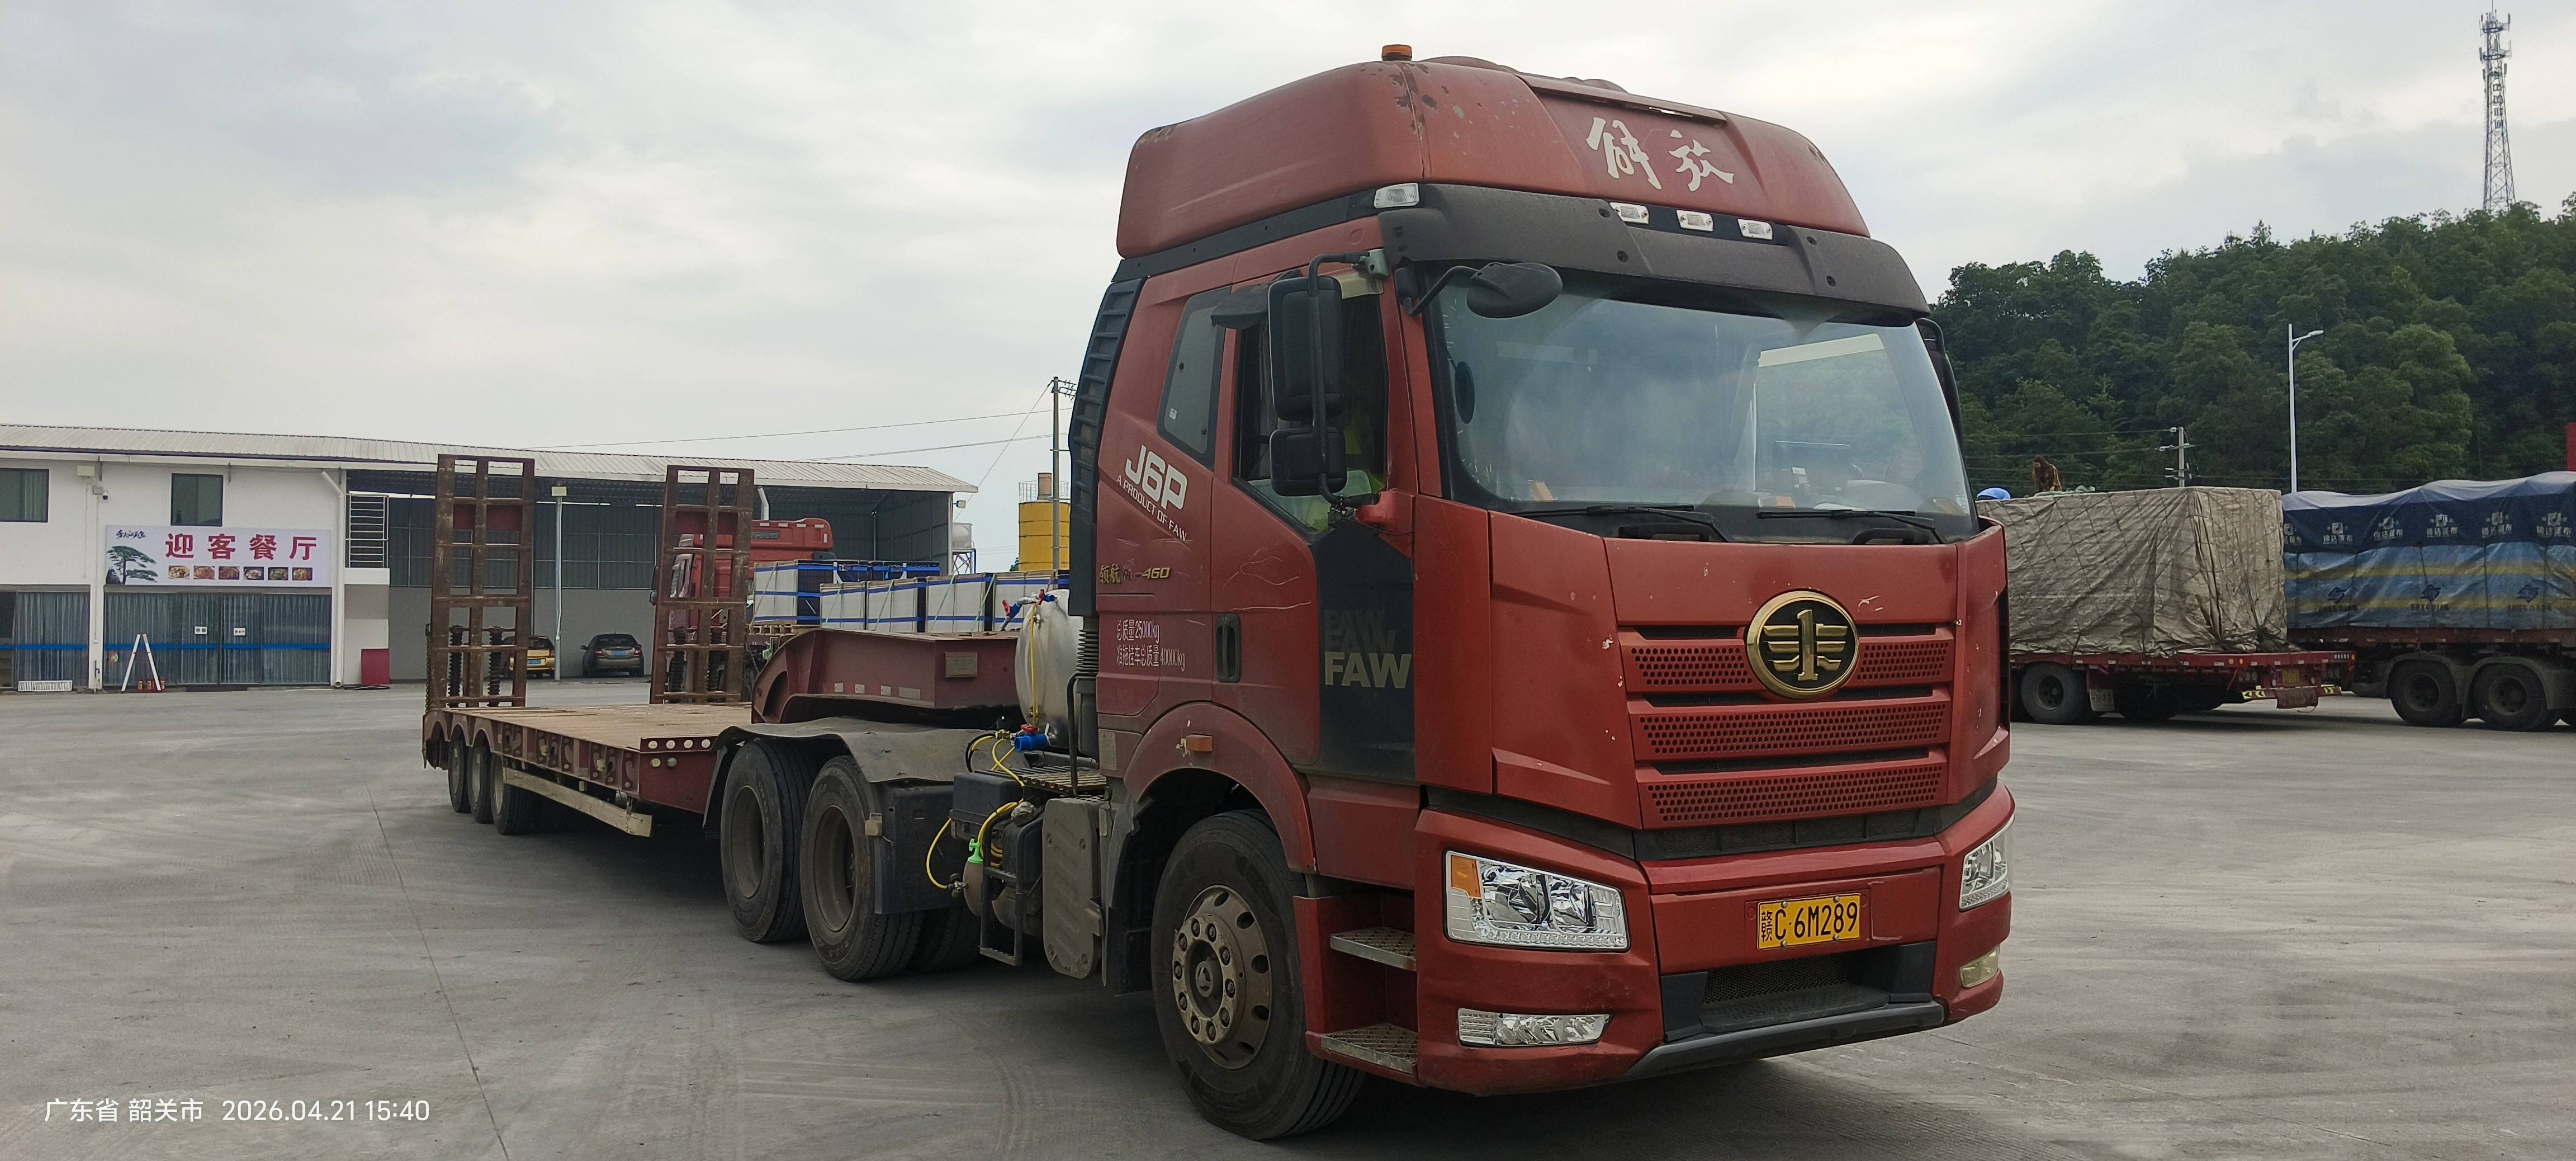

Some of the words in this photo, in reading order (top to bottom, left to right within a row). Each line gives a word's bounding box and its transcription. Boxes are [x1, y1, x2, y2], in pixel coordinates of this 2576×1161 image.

[1586, 117, 1735, 192] 解放
[1116, 475, 1121, 486] A
[1123, 479, 1157, 515] PRODUCT
[1157, 510, 1168, 524] OF
[1169, 519, 1187, 542] FAW
[1125, 444, 1187, 510] J6P
[165, 533, 317, 560] 迎客餐厅
[1325, 652, 1412, 689] FAW
